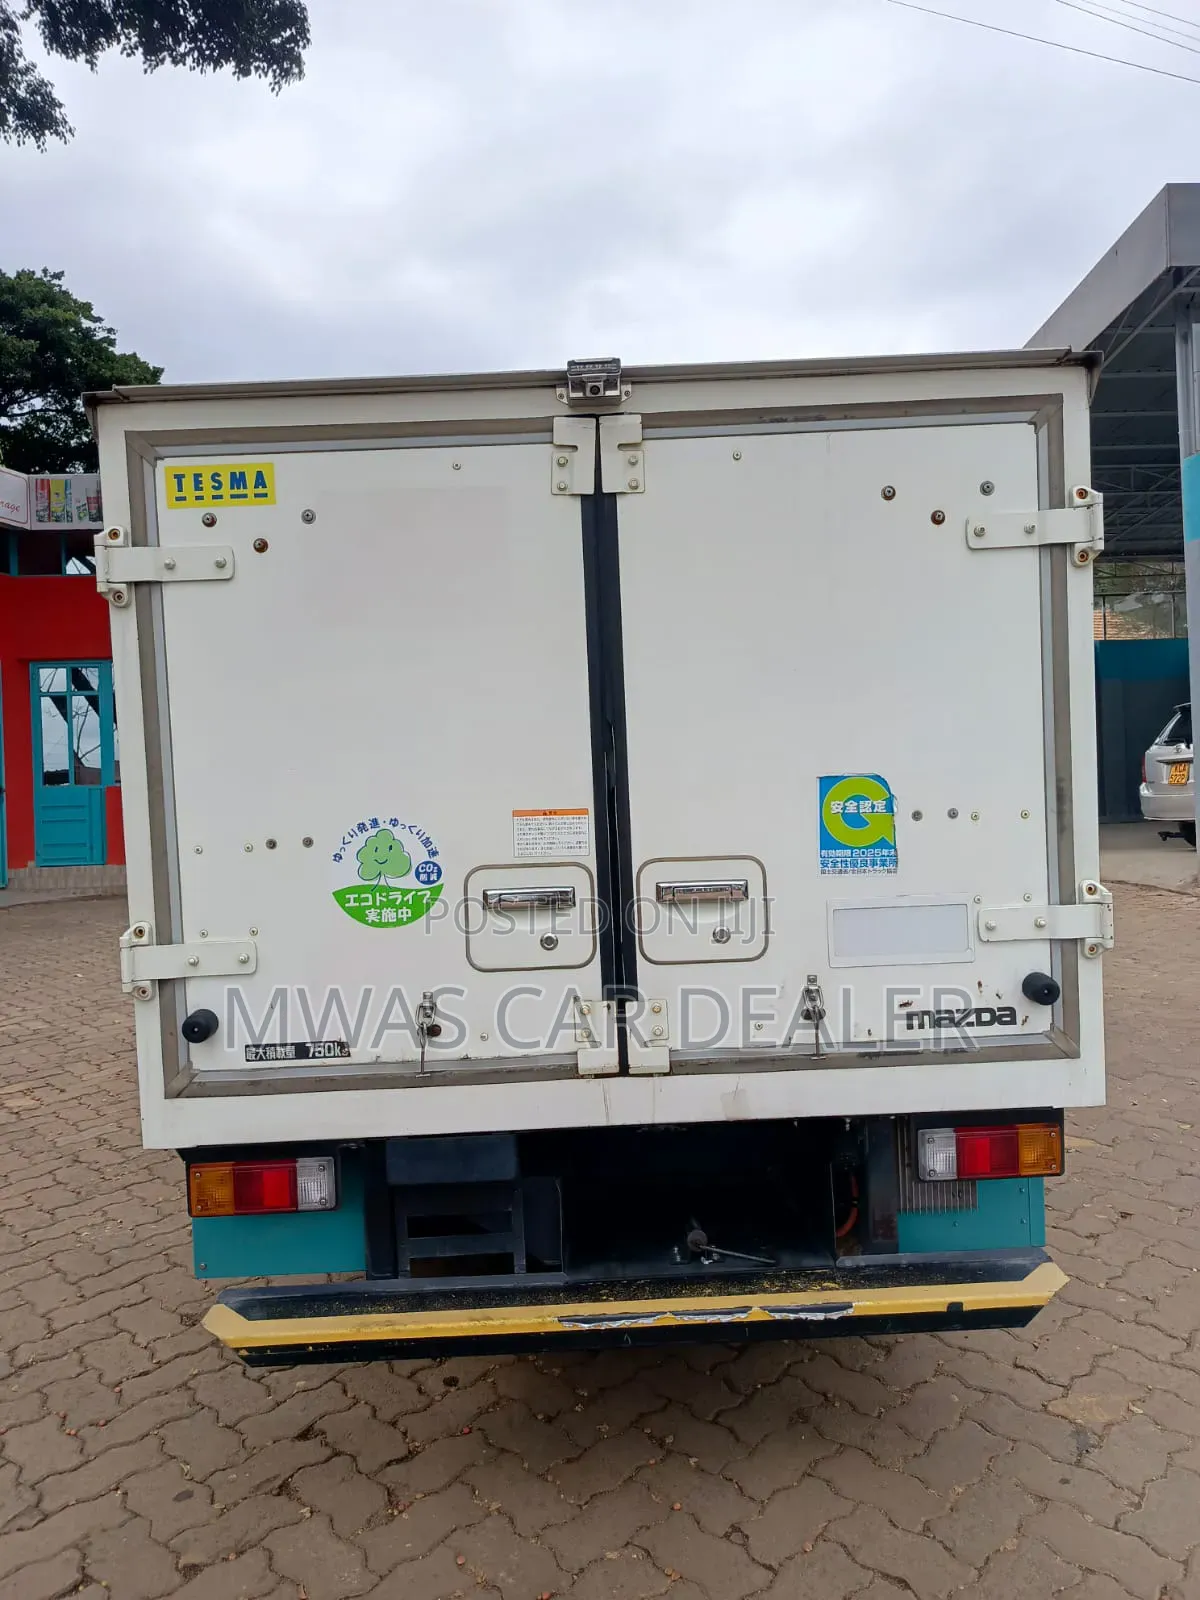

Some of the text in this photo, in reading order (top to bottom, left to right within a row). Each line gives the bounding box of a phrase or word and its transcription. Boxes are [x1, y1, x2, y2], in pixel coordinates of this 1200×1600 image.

[173, 470, 268, 493] TESMA
[830, 800, 887, 814] 安全認定
[365, 906, 412, 923] 実施中
